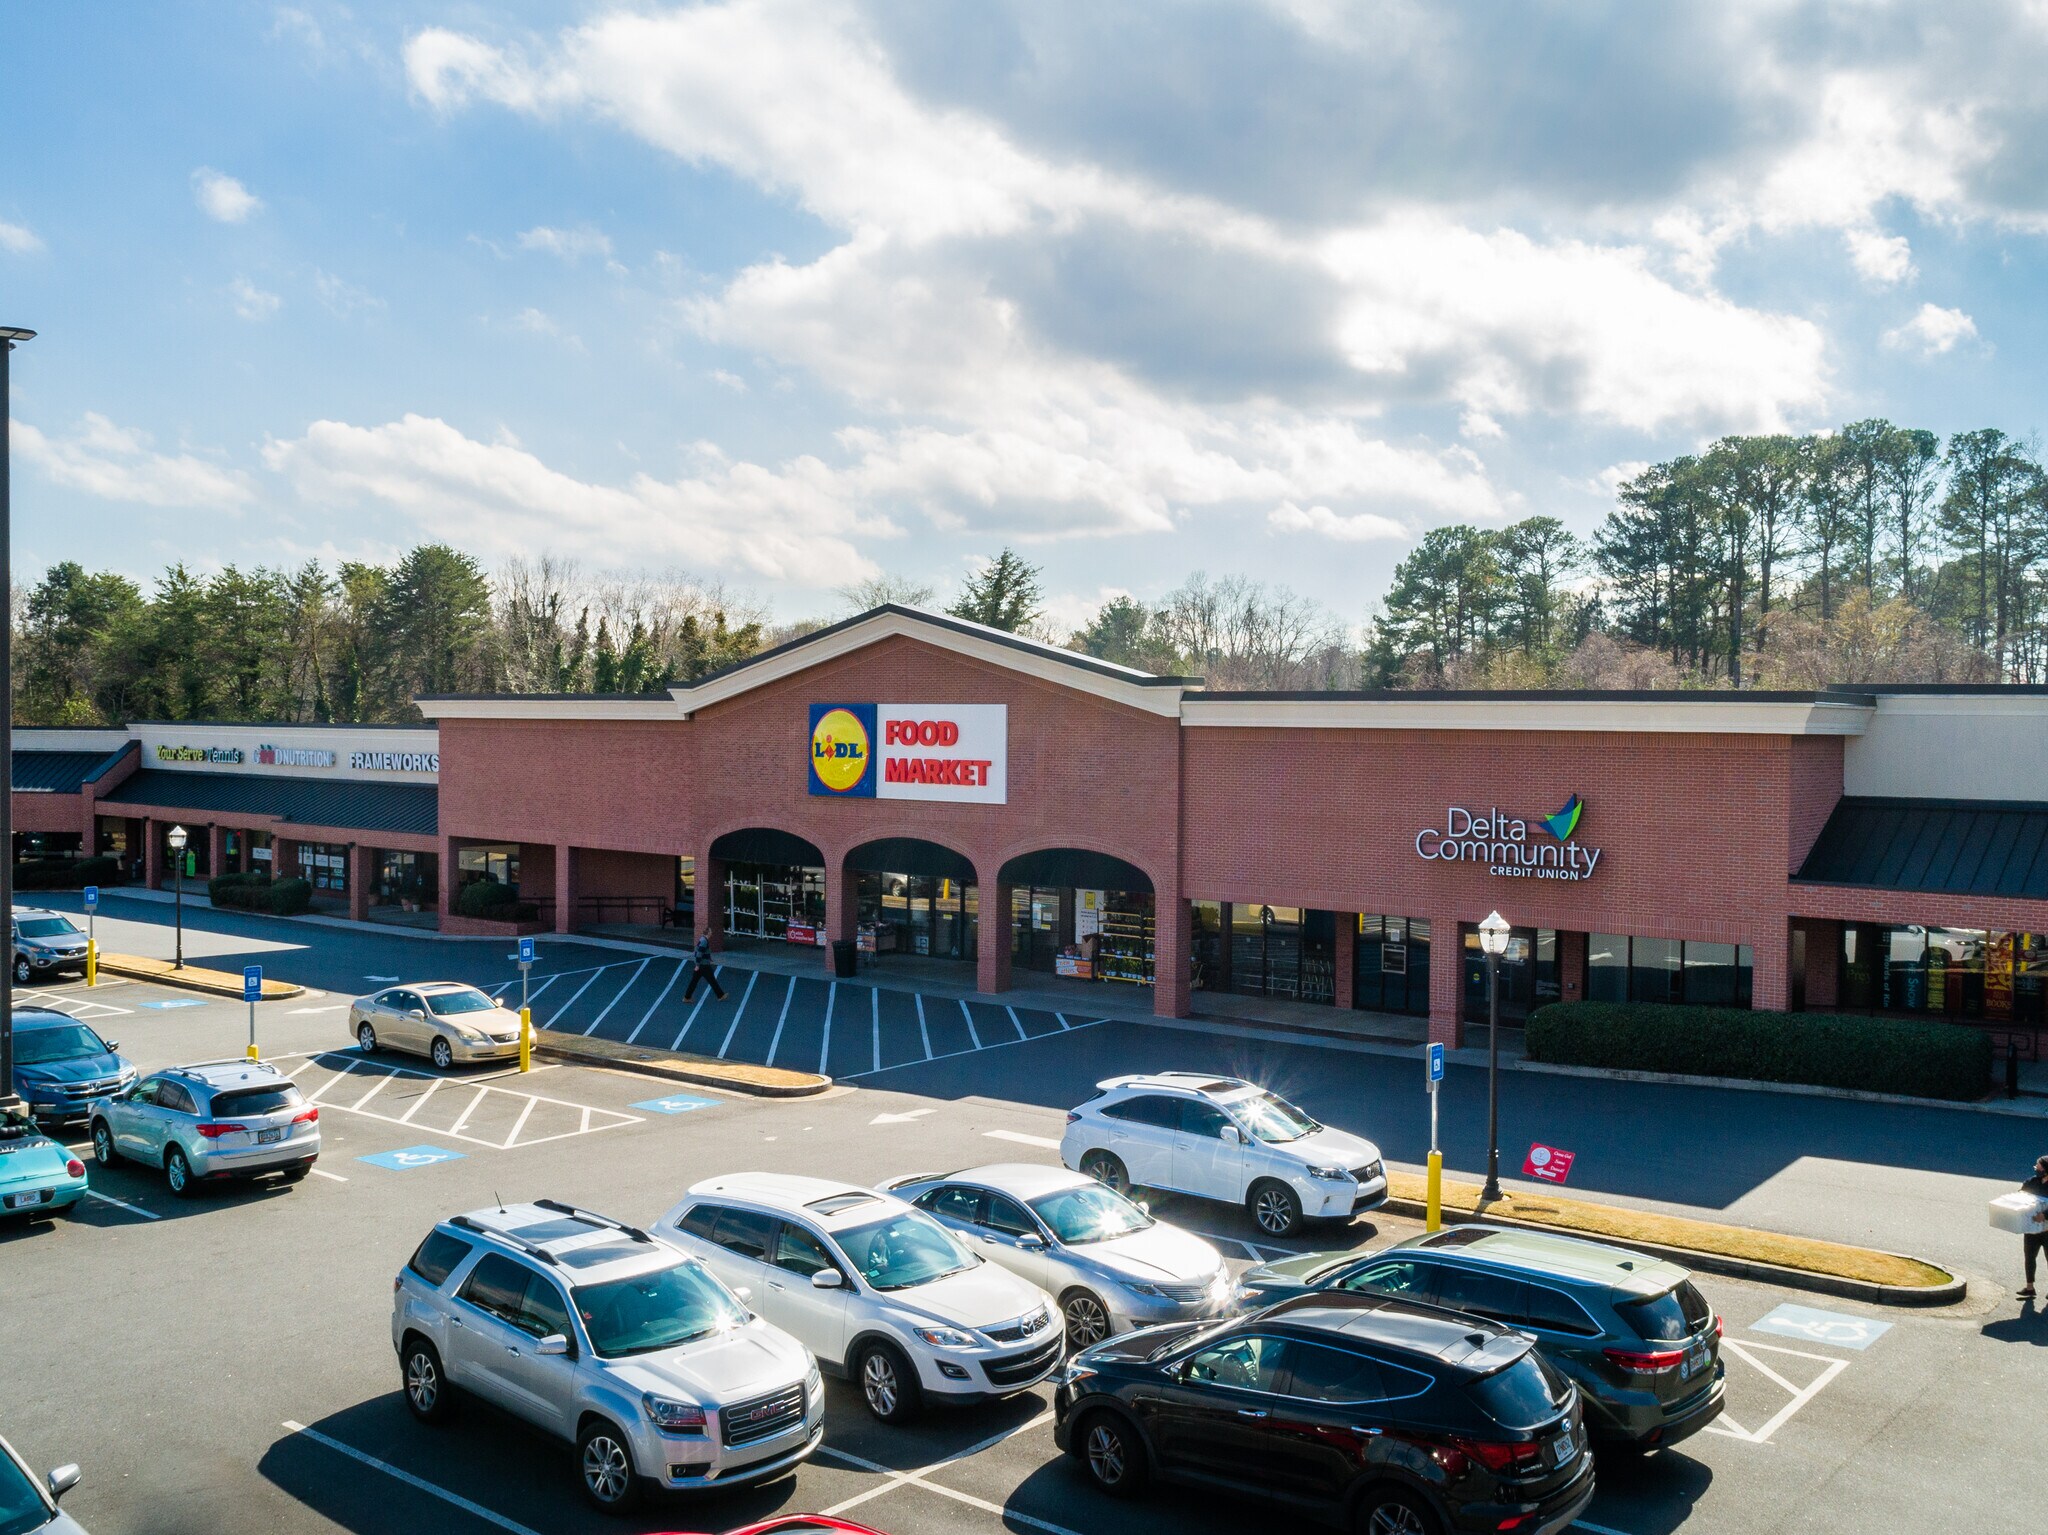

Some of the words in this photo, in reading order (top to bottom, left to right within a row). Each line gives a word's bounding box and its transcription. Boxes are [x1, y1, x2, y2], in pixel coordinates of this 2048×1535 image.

[885, 720, 959, 747] FOOD
[157, 745, 178, 761] Your
[178, 745, 204, 761] Serve
[207, 747, 240, 764] Tennis
[350, 752, 439, 772] FRAMEWORKS
[885, 757, 992, 786] MARKET
[1448, 807, 1526, 841] Delta
[1415, 829, 1600, 879] Community
[1489, 865, 1533, 878] CREDIT
[1537, 868, 1579, 881] UNION
[751, 1400, 786, 1420] GMC
